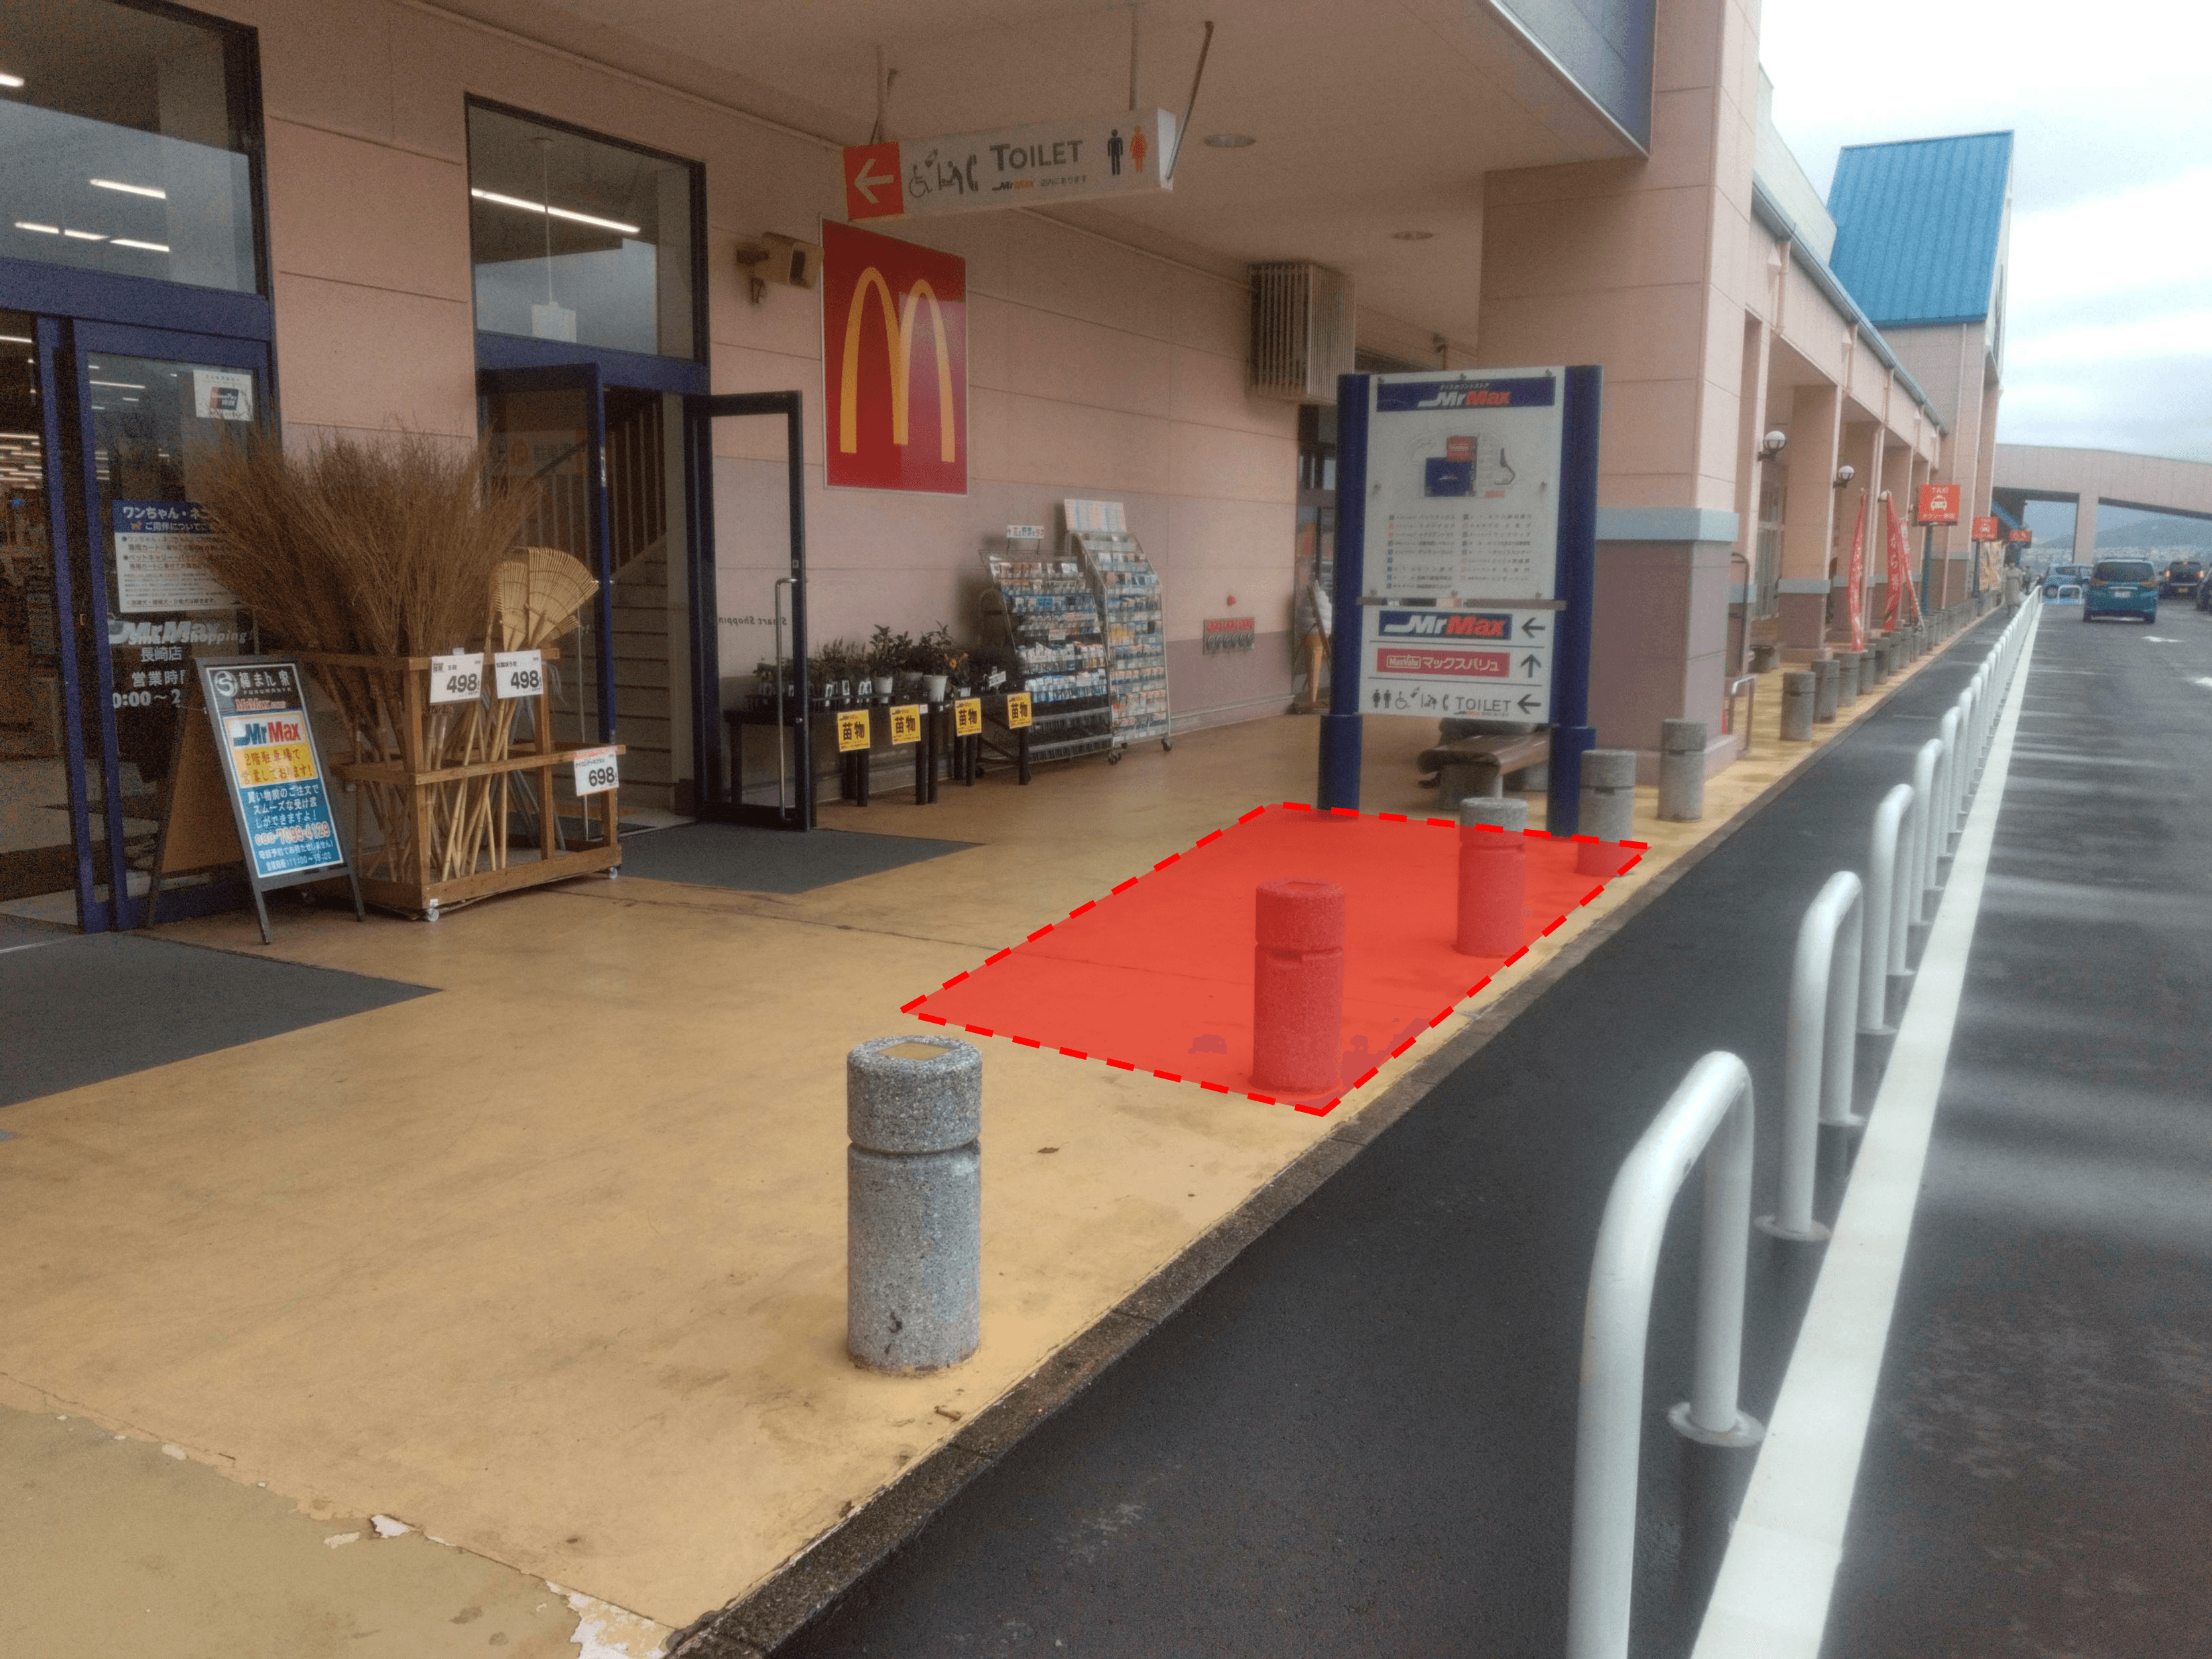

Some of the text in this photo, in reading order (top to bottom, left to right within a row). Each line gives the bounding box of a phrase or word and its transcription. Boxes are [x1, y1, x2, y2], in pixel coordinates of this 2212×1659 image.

[989, 139, 1083, 171] TOILET
[1418, 391, 1510, 408] MrMax
[1384, 615, 1508, 637] MrMax
[141, 646, 182, 662] 長崎店
[1422, 657, 1500, 672] マックスバリュ
[239, 670, 291, 689] 福まん家
[446, 673, 478, 694] 498
[511, 670, 540, 689] 498
[1455, 696, 1512, 713] TOILET
[233, 721, 302, 747] MrMax
[589, 766, 615, 787] 698
